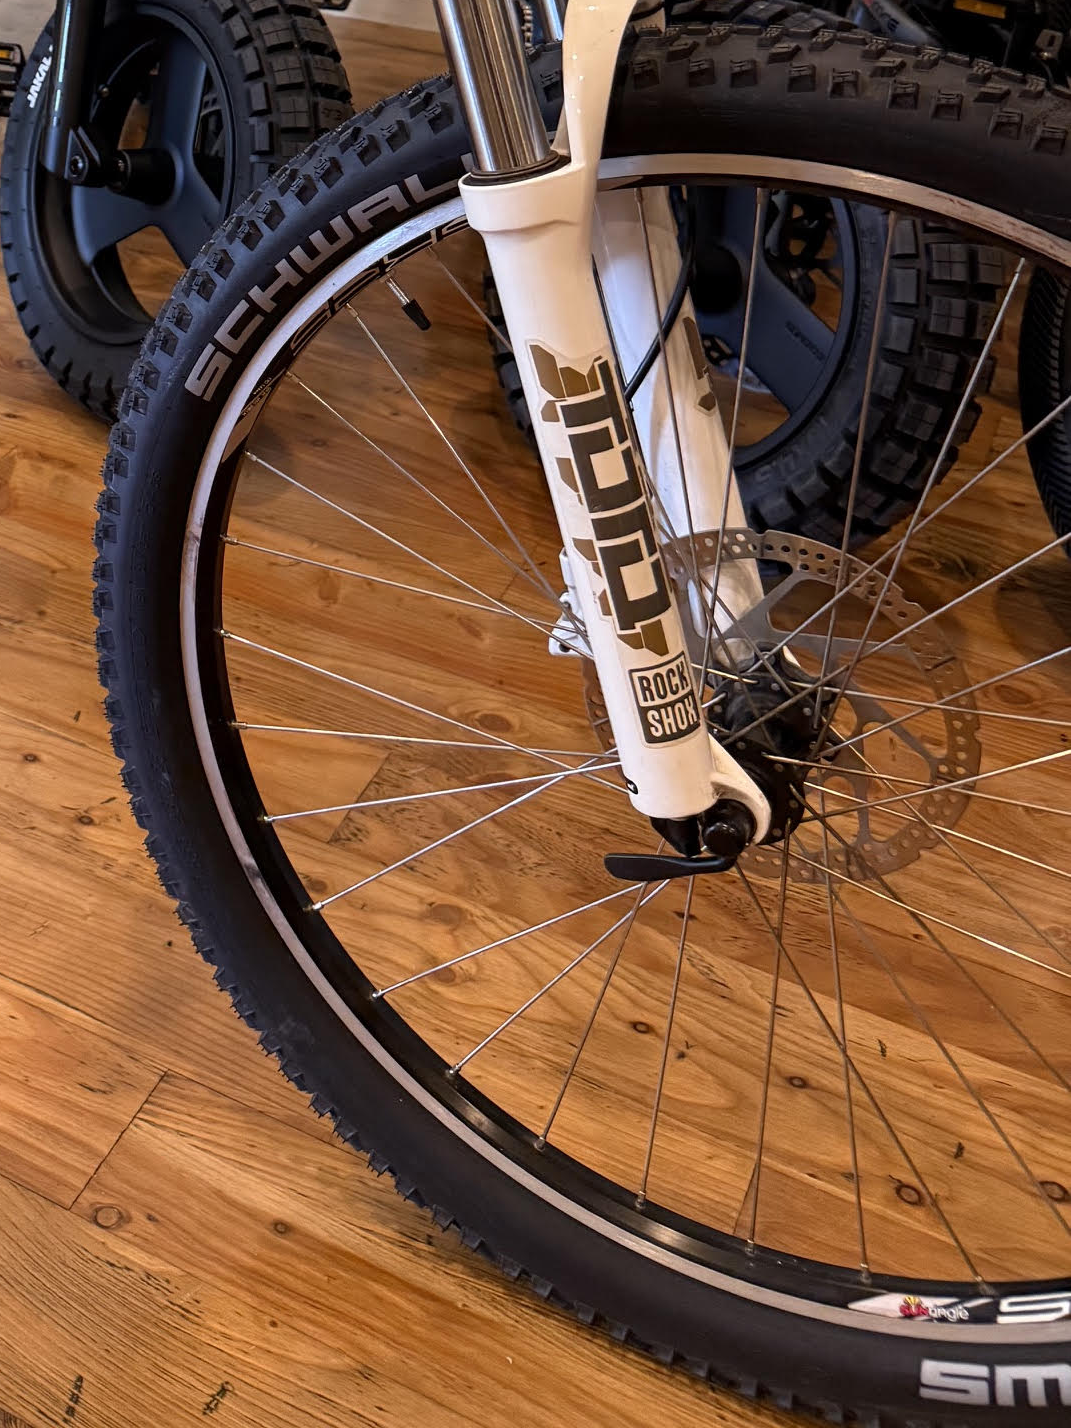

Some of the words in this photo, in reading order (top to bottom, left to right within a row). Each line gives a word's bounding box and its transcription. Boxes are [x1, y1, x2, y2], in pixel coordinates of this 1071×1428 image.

[185, 153, 476, 401] SCHWAL
[637, 662, 690, 703] ROCK
[647, 694, 698, 738] SHOX
